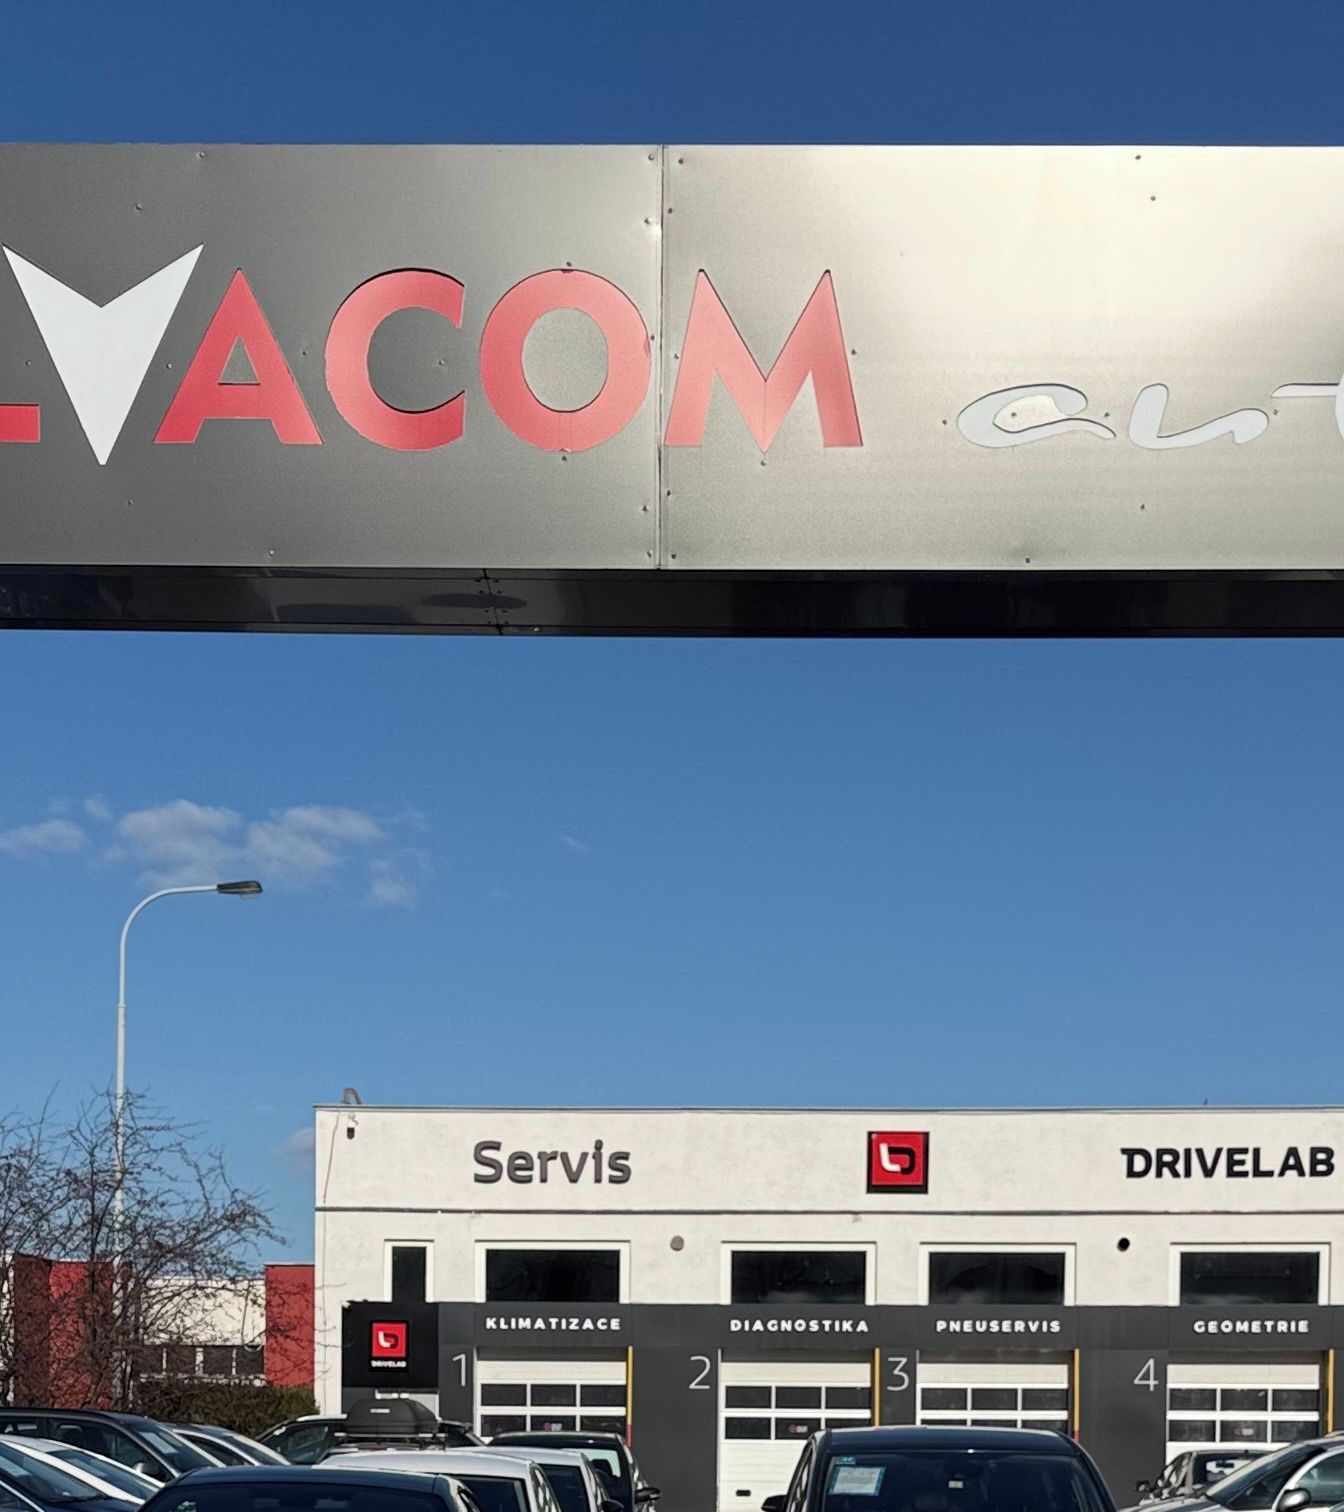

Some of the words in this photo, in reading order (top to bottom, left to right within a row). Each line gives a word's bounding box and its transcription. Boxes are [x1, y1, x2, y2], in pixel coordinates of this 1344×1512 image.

[472, 1139, 633, 1184] Servis
[1120, 1147, 1335, 1178] DRIVELAB
[485, 1317, 621, 1331] KLIMATIZACE
[730, 1319, 869, 1333] DIAGNOSTIKA
[936, 1320, 1062, 1333] PNEUSERVIS
[1193, 1320, 1310, 1333] GEOMETRIE
[452, 1353, 466, 1387] 1
[689, 1356, 711, 1390] 2
[886, 1357, 909, 1392] 3
[1133, 1358, 1158, 1392] 4
